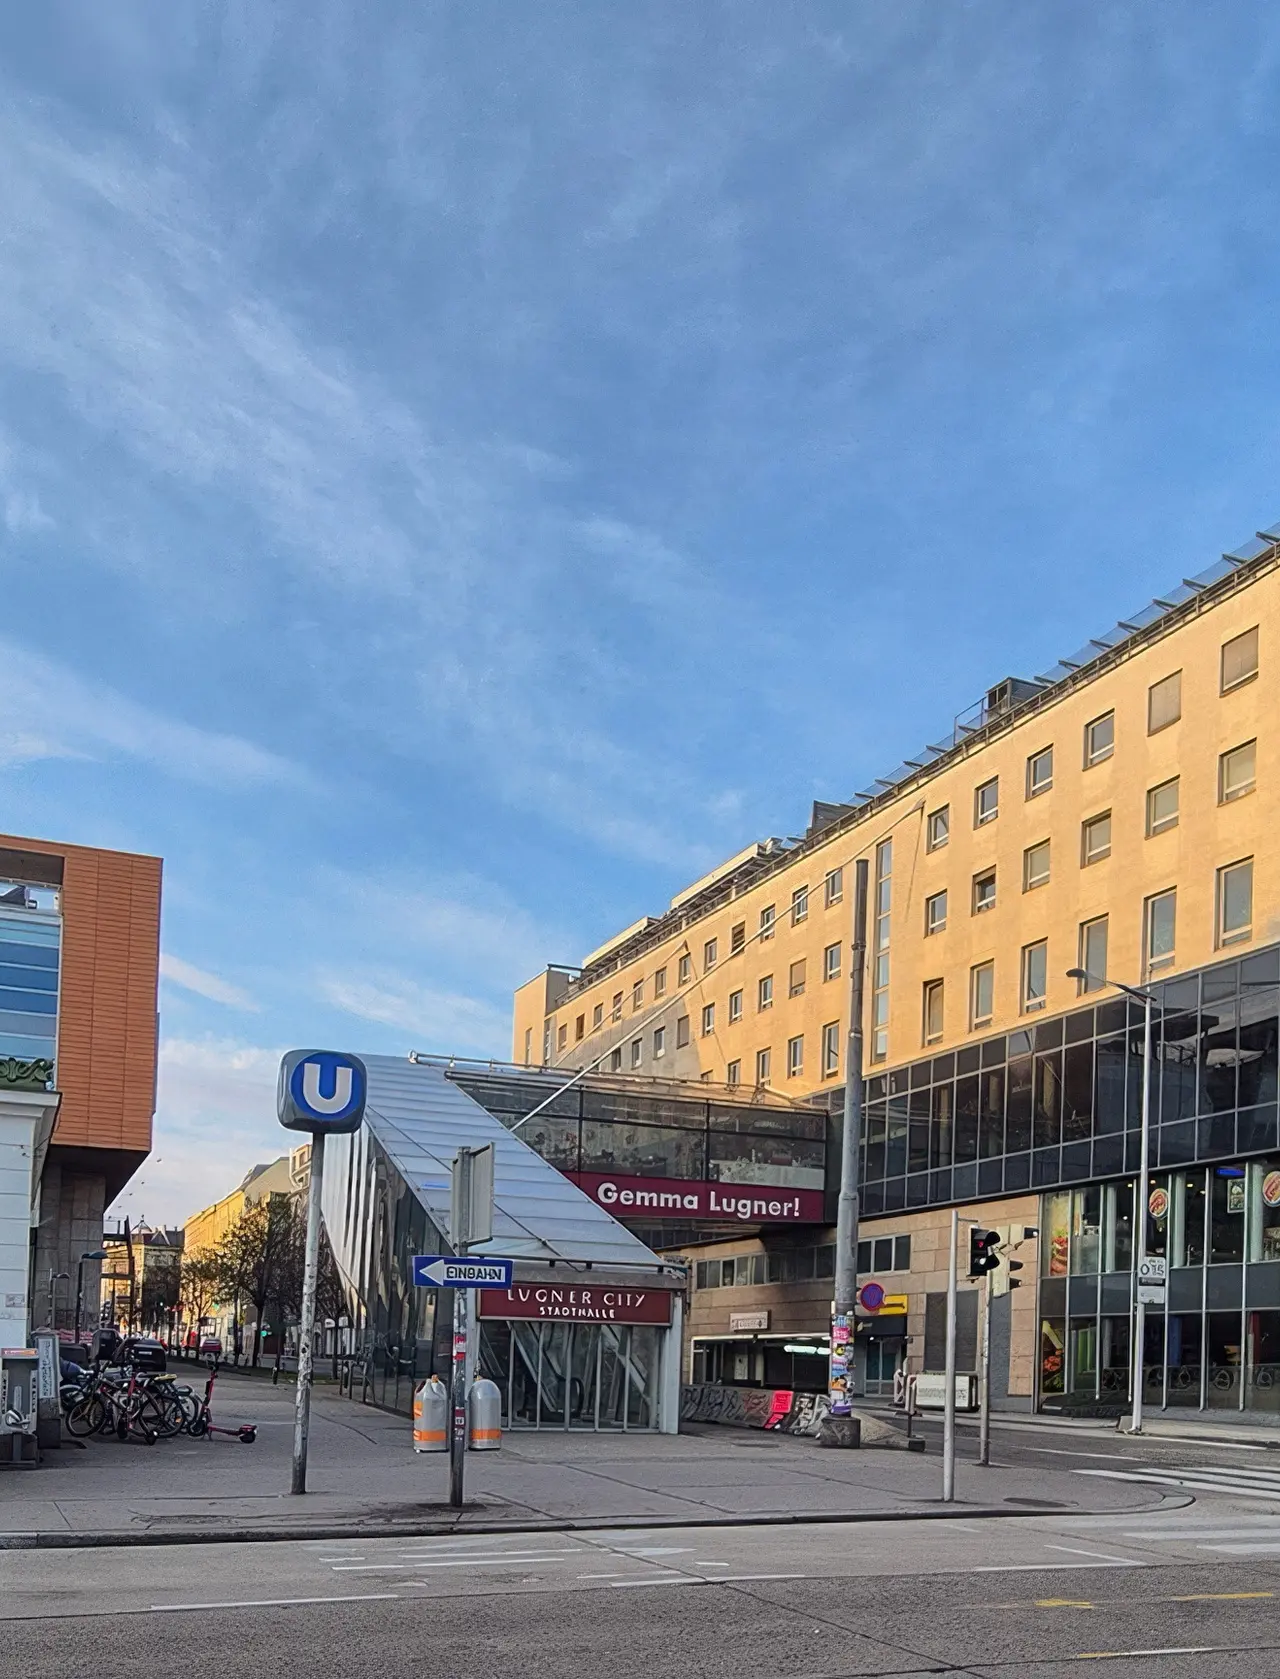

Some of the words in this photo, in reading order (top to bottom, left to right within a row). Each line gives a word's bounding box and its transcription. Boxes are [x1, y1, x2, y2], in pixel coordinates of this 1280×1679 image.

[303, 1062, 353, 1114] U
[597, 1182, 699, 1210] Gemma
[709, 1190, 800, 1220] Lugner!
[446, 1265, 503, 1282] EINBAHN
[507, 1287, 593, 1306] LUGNER
[603, 1292, 646, 1308] CITY
